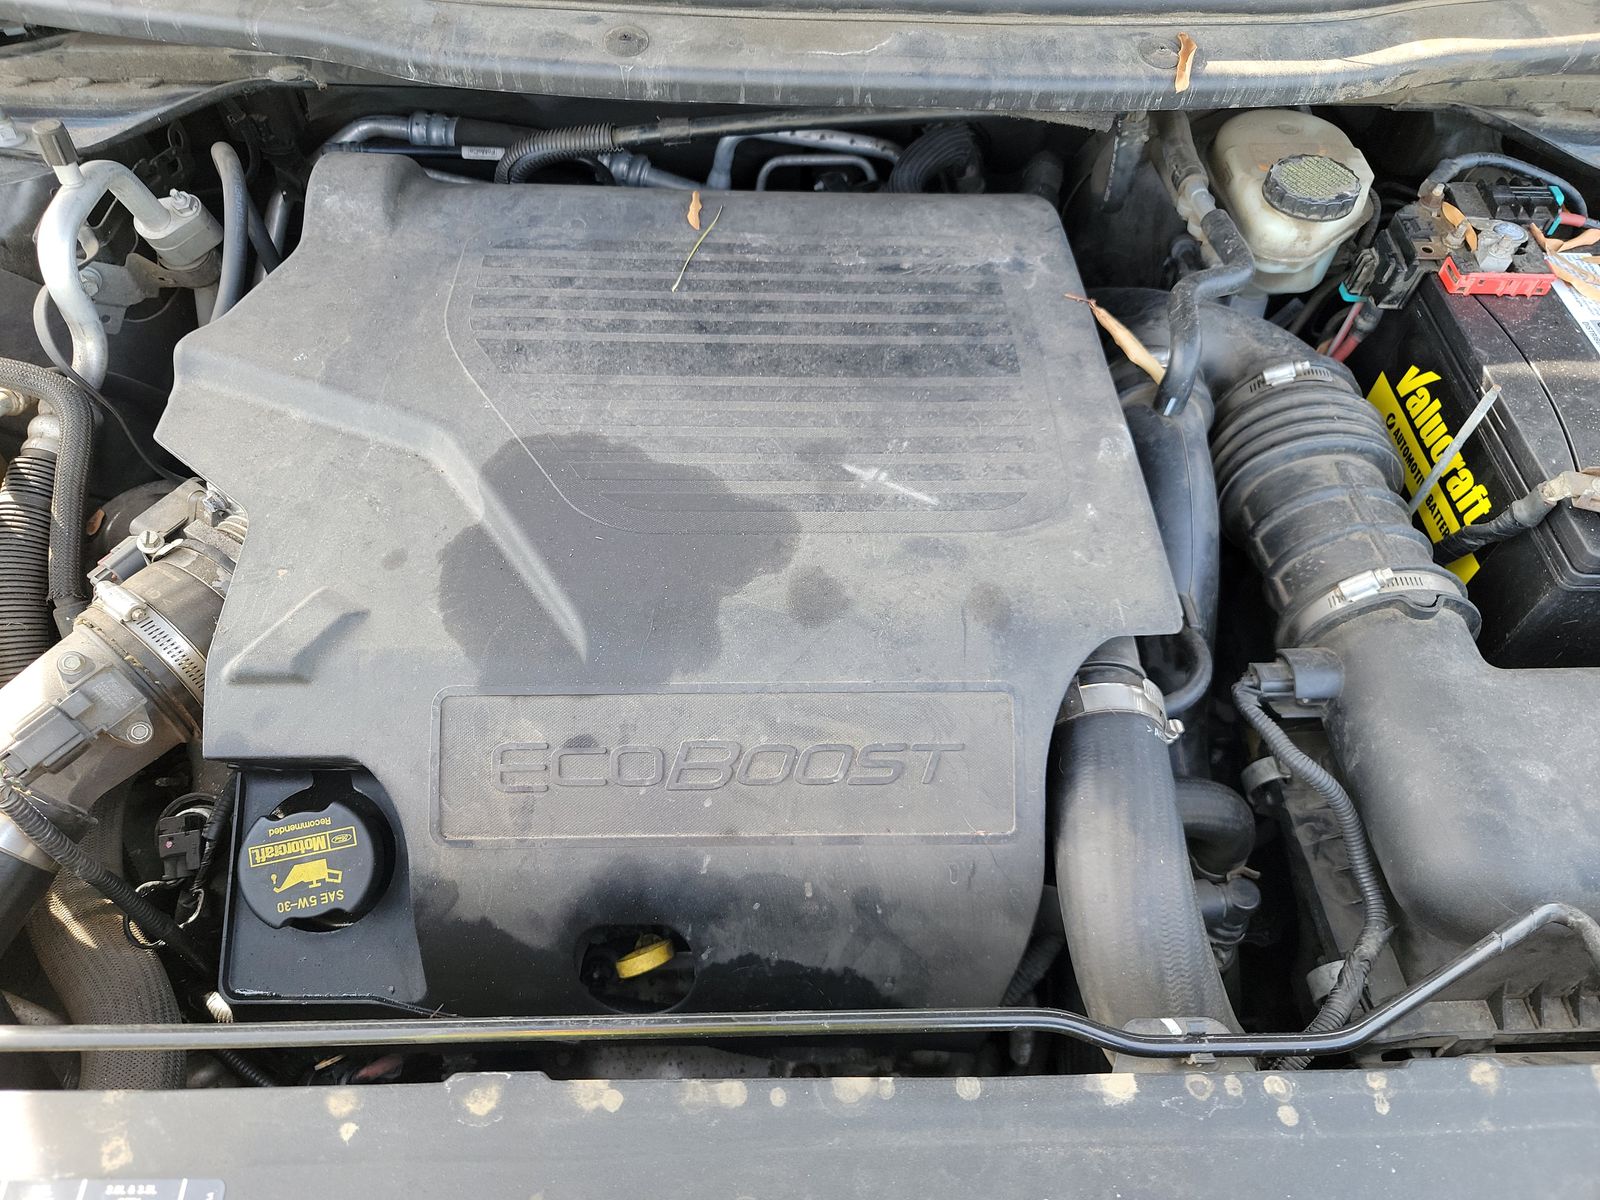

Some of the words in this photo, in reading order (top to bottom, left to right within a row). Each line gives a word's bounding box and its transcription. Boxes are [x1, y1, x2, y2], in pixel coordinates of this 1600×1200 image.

[1393, 428, 1426, 487] AUTOMOTI
[1425, 494, 1450, 537] BATTER
[268, 817, 331, 836] Recommended
[253, 835, 326, 863] Motorcraft
[277, 896, 317, 913] 5W-30
[320, 890, 344, 904] SAE
